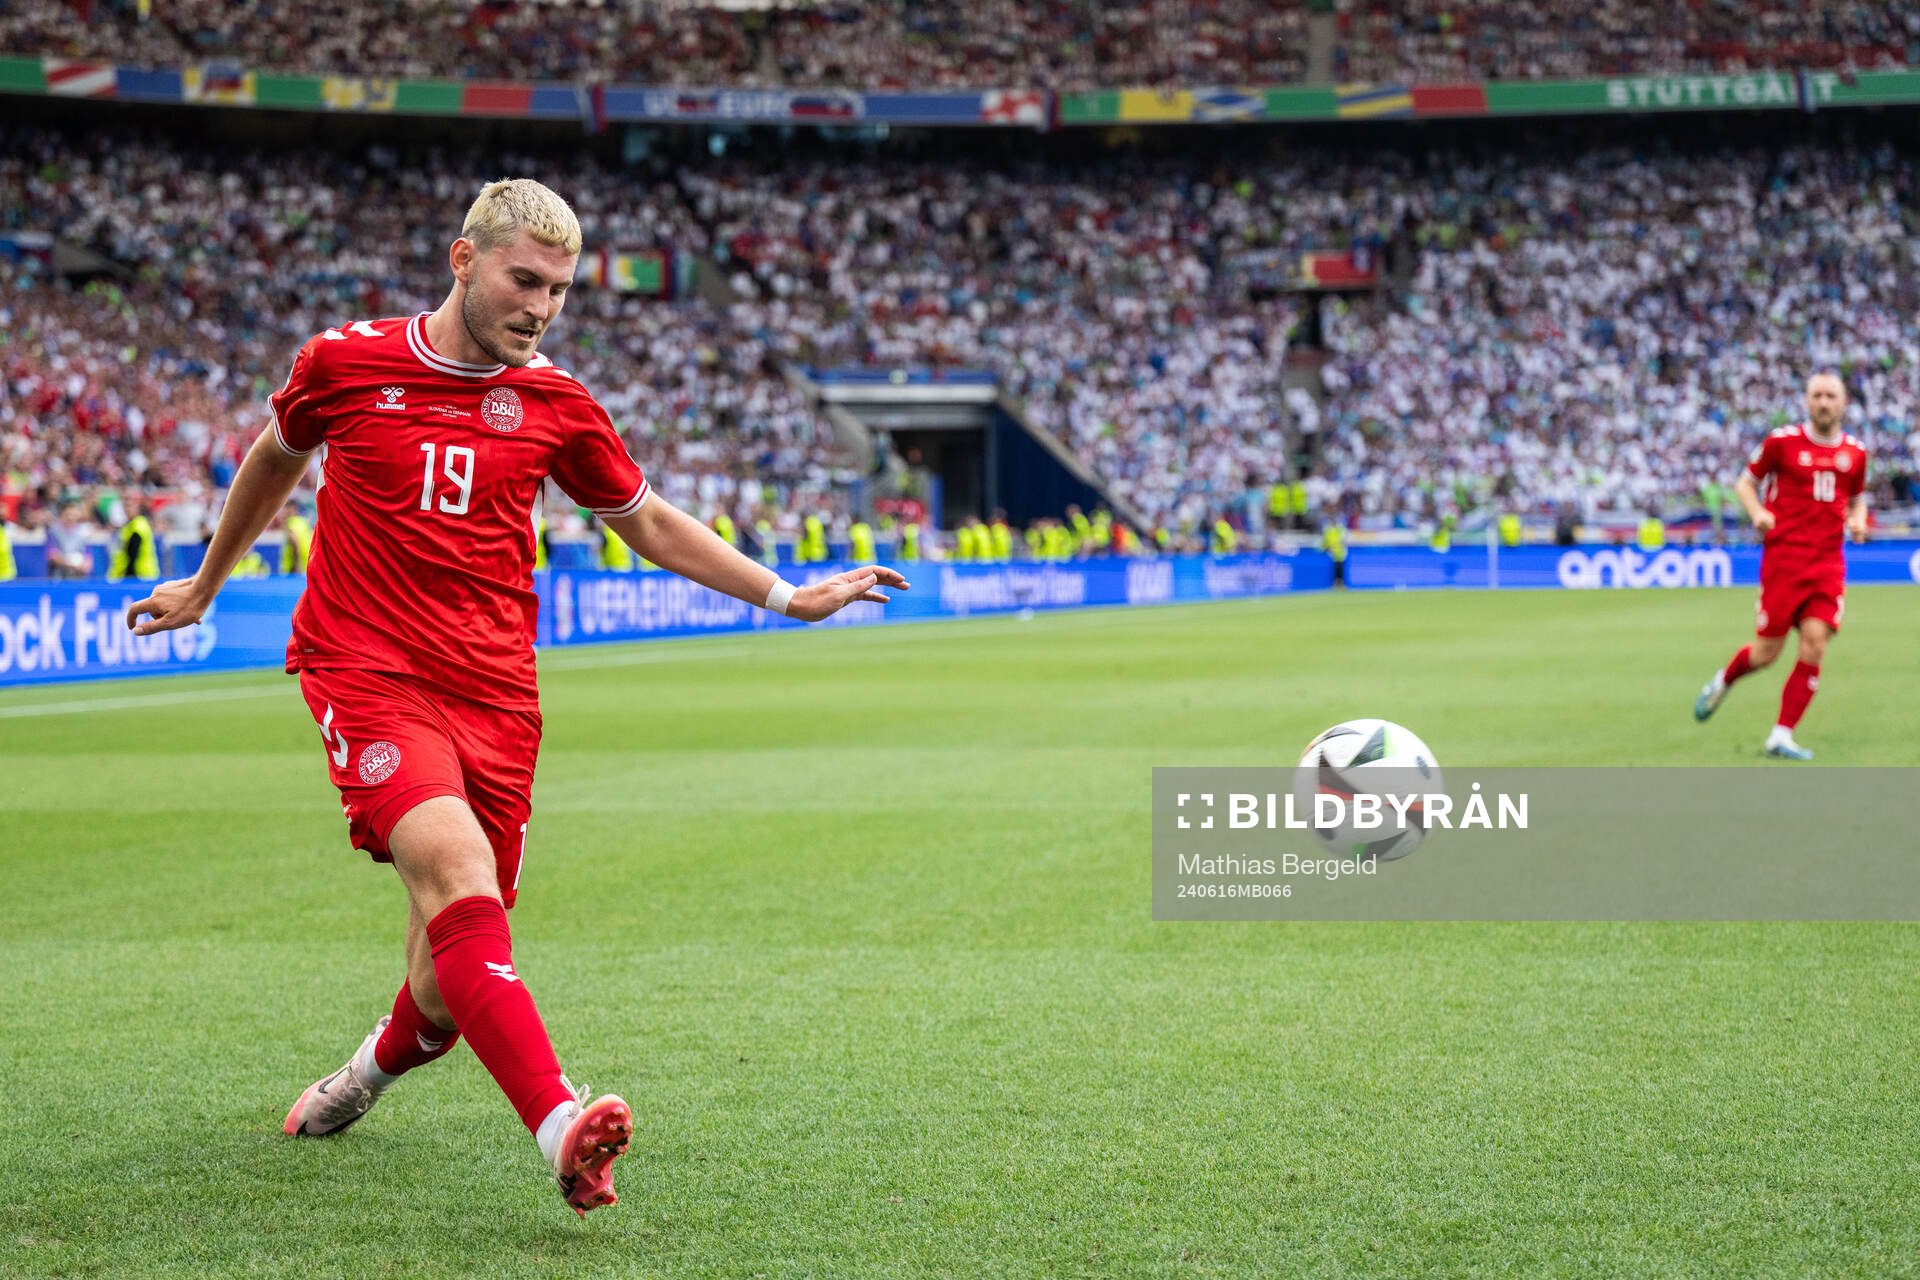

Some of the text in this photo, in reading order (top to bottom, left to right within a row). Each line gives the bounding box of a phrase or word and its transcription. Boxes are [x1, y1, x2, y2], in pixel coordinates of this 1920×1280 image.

[376, 401, 405, 410] hummel
[490, 401, 516, 418] DBU
[420, 442, 475, 515] 19
[1813, 470, 1836, 502] 10
[1557, 547, 1733, 588] antom
[366, 751, 391, 774] DBU
